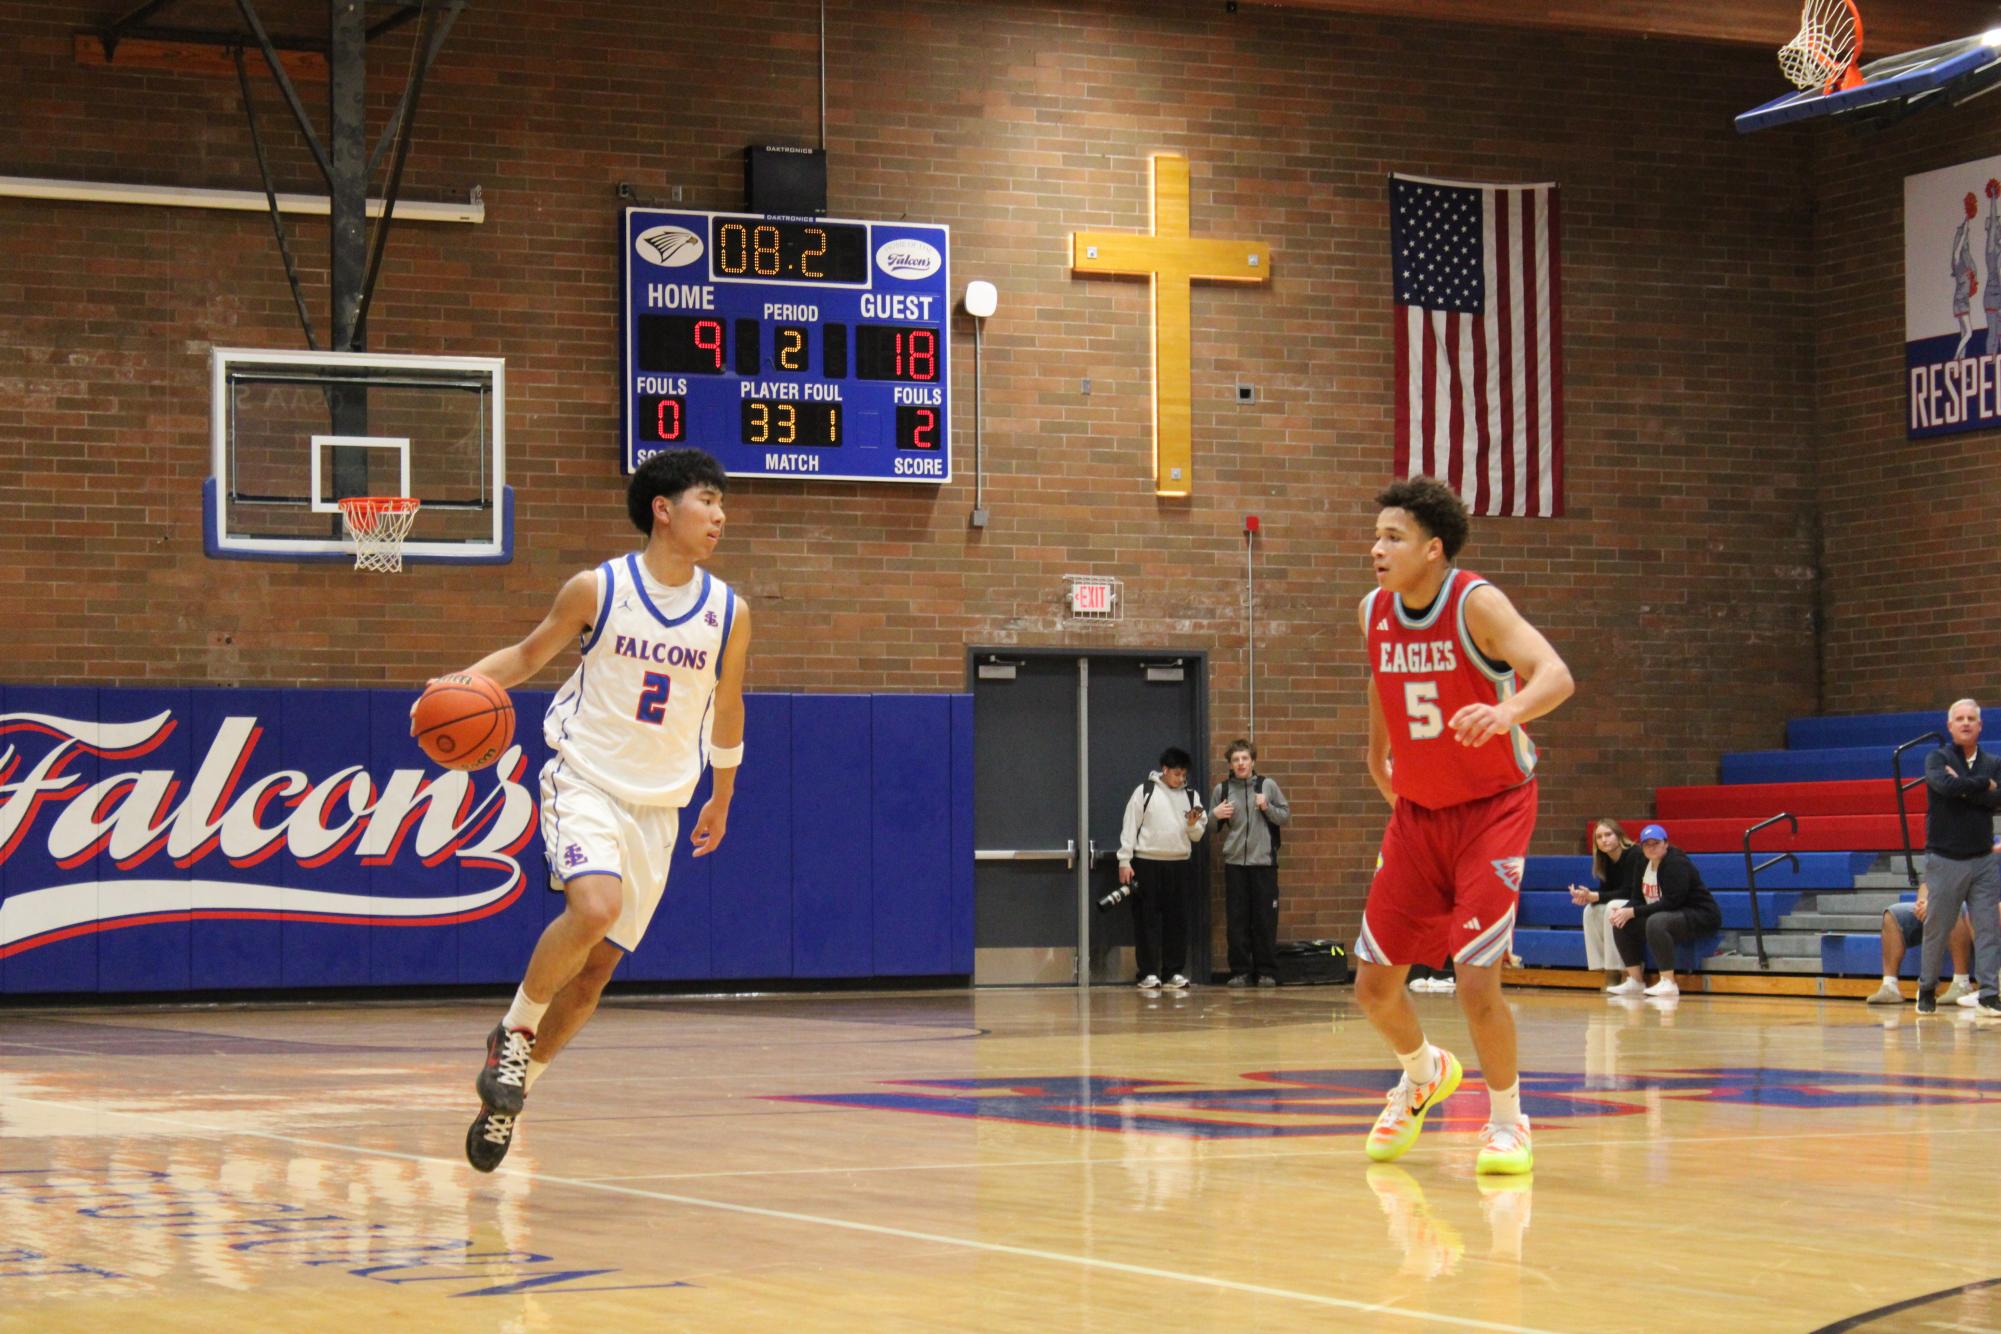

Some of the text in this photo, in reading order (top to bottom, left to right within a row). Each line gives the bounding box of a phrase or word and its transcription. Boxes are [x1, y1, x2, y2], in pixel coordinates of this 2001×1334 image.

[766, 146, 813, 154] DAKTRONICS
[888, 253, 931, 267] Falcons
[648, 283, 715, 310] HOME
[860, 294, 932, 321] GUEST
[763, 303, 818, 321] PERIOD
[694, 320, 721, 369] 9
[781, 330, 801, 369] 2
[895, 330, 935, 380] 18
[637, 376, 687, 396] FOULS
[740, 381, 843, 401] PLAYER FOUL
[894, 387, 942, 405] FOULS
[658, 399, 679, 440] 0
[750, 403, 836, 444] 33 1
[914, 408, 935, 449] 2
[765, 453, 819, 472] MATCH
[894, 458, 943, 475] SCORE
[1080, 586, 1105, 609] EXIT
[615, 635, 707, 671] FALCONS
[1379, 640, 1458, 674] EAGLES
[635, 671, 671, 726] 2
[1403, 681, 1444, 741] 5
[0, 709, 539, 875] Falcons
